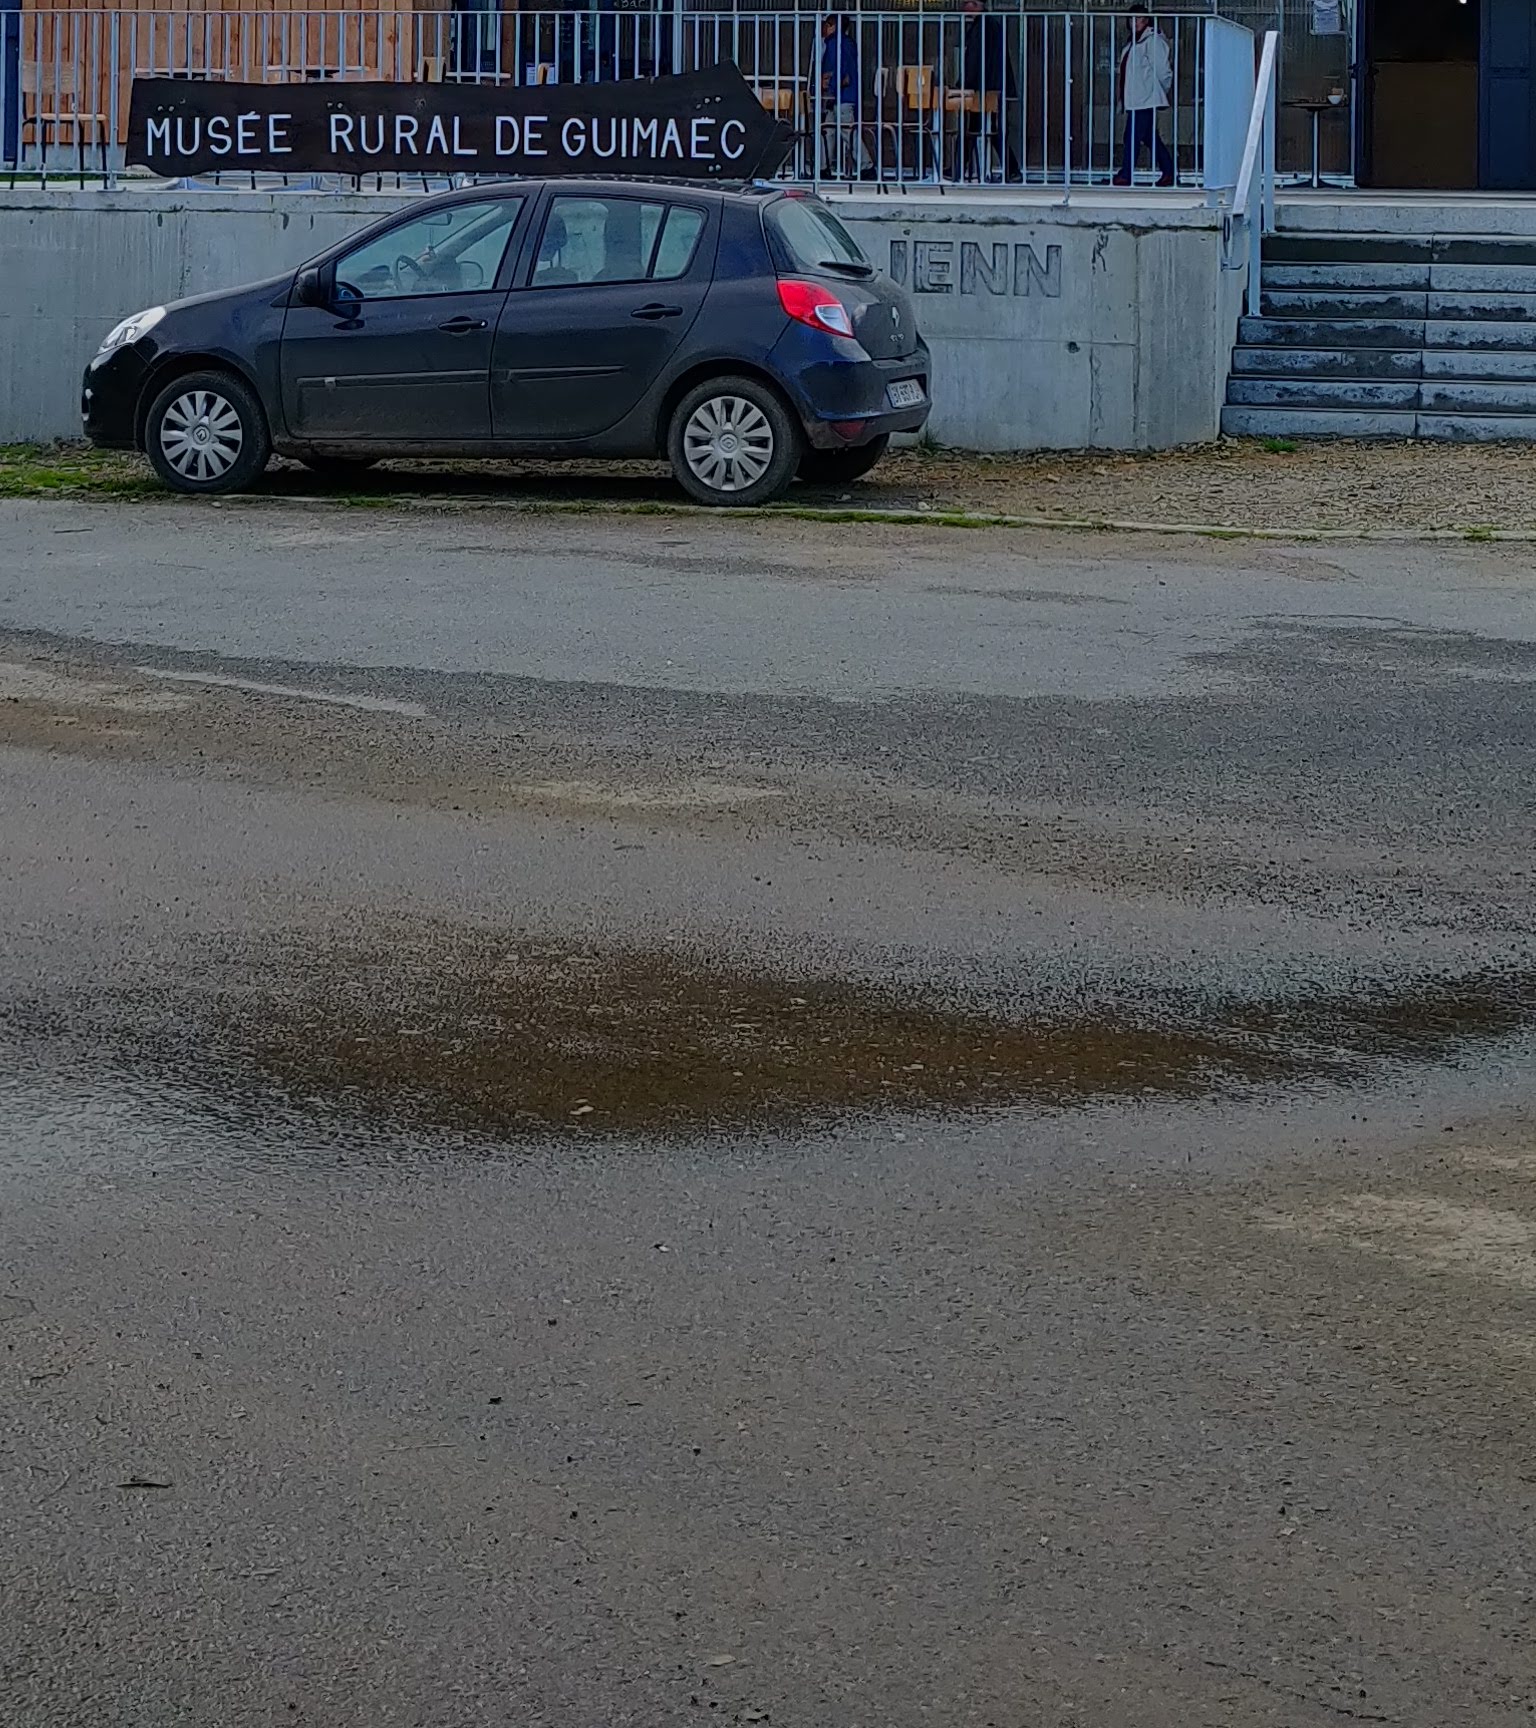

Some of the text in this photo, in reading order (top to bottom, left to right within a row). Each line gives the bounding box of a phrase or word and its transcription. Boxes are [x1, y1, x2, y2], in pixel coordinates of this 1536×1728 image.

[146, 111, 747, 160] MUSÉE RURAL DE GUIMAËC
